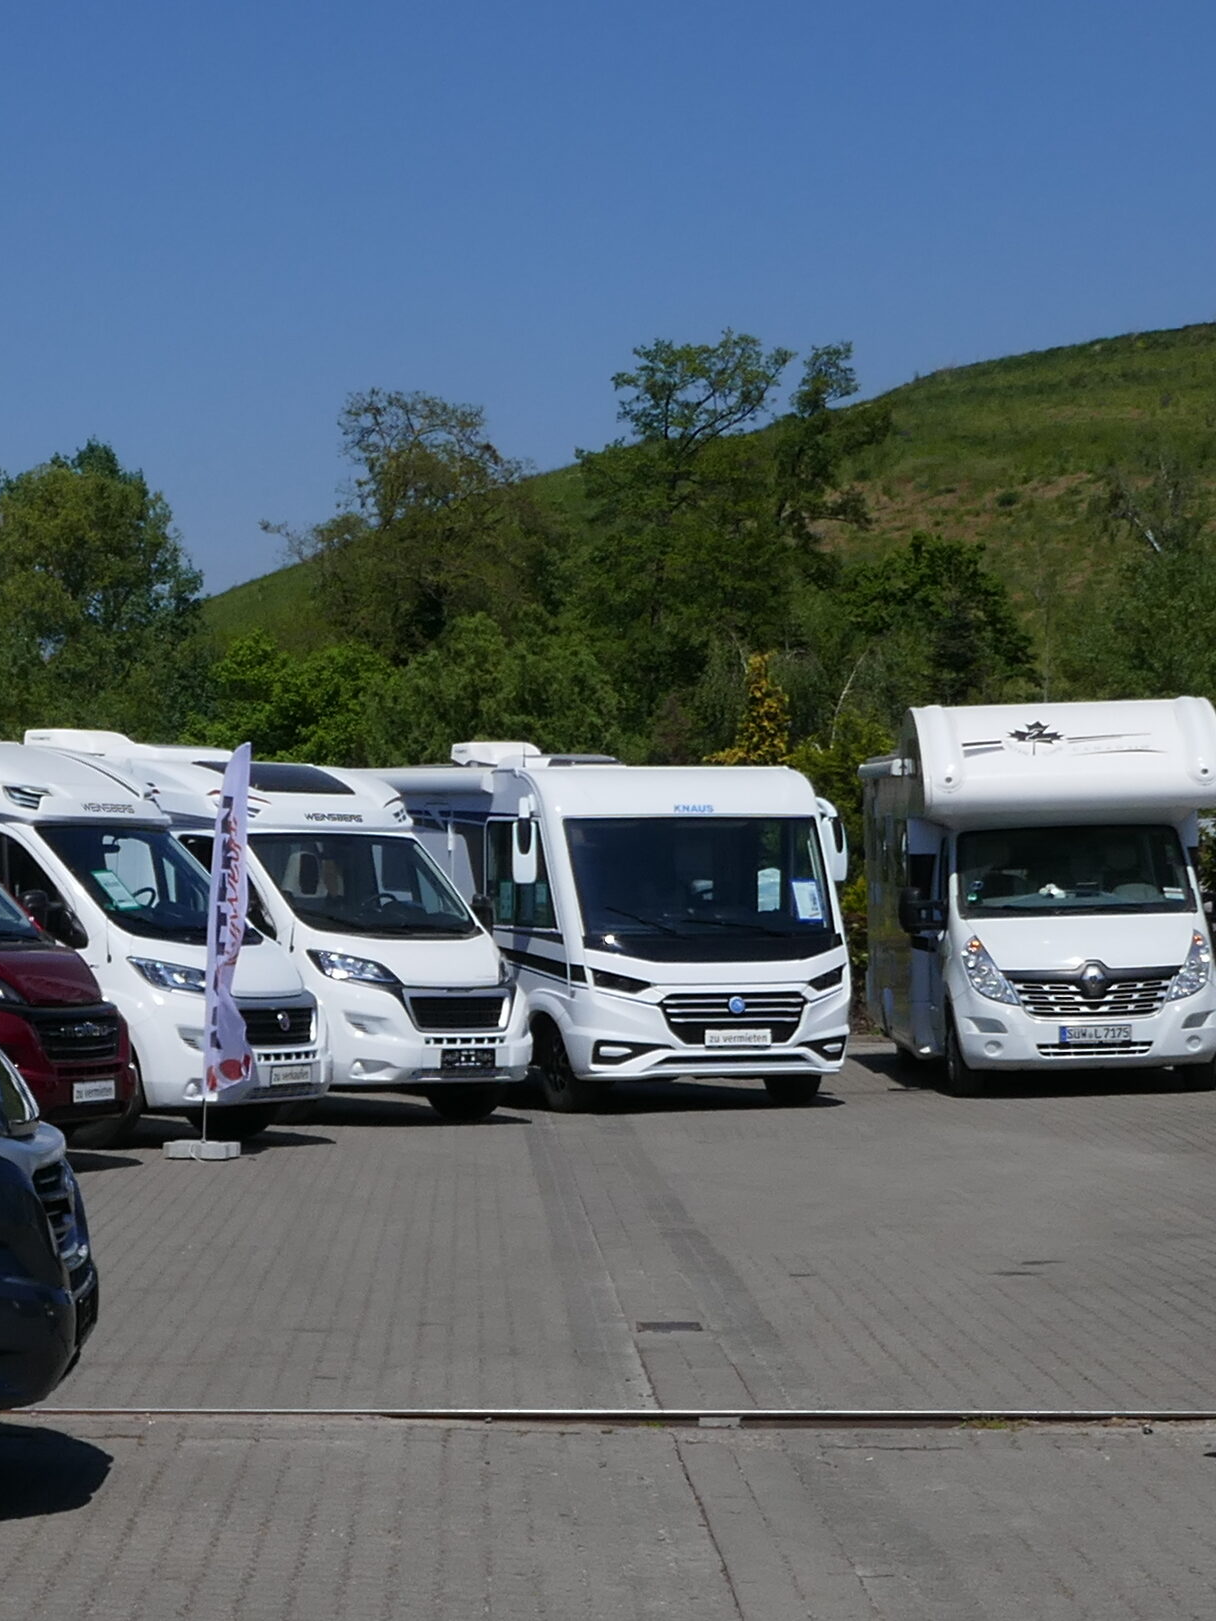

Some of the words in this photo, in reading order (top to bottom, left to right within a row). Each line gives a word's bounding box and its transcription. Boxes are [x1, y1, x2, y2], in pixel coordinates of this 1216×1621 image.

[674, 804, 714, 813] KNAUS
[709, 1035, 720, 1043] zu
[722, 1032, 767, 1043] vermieten
